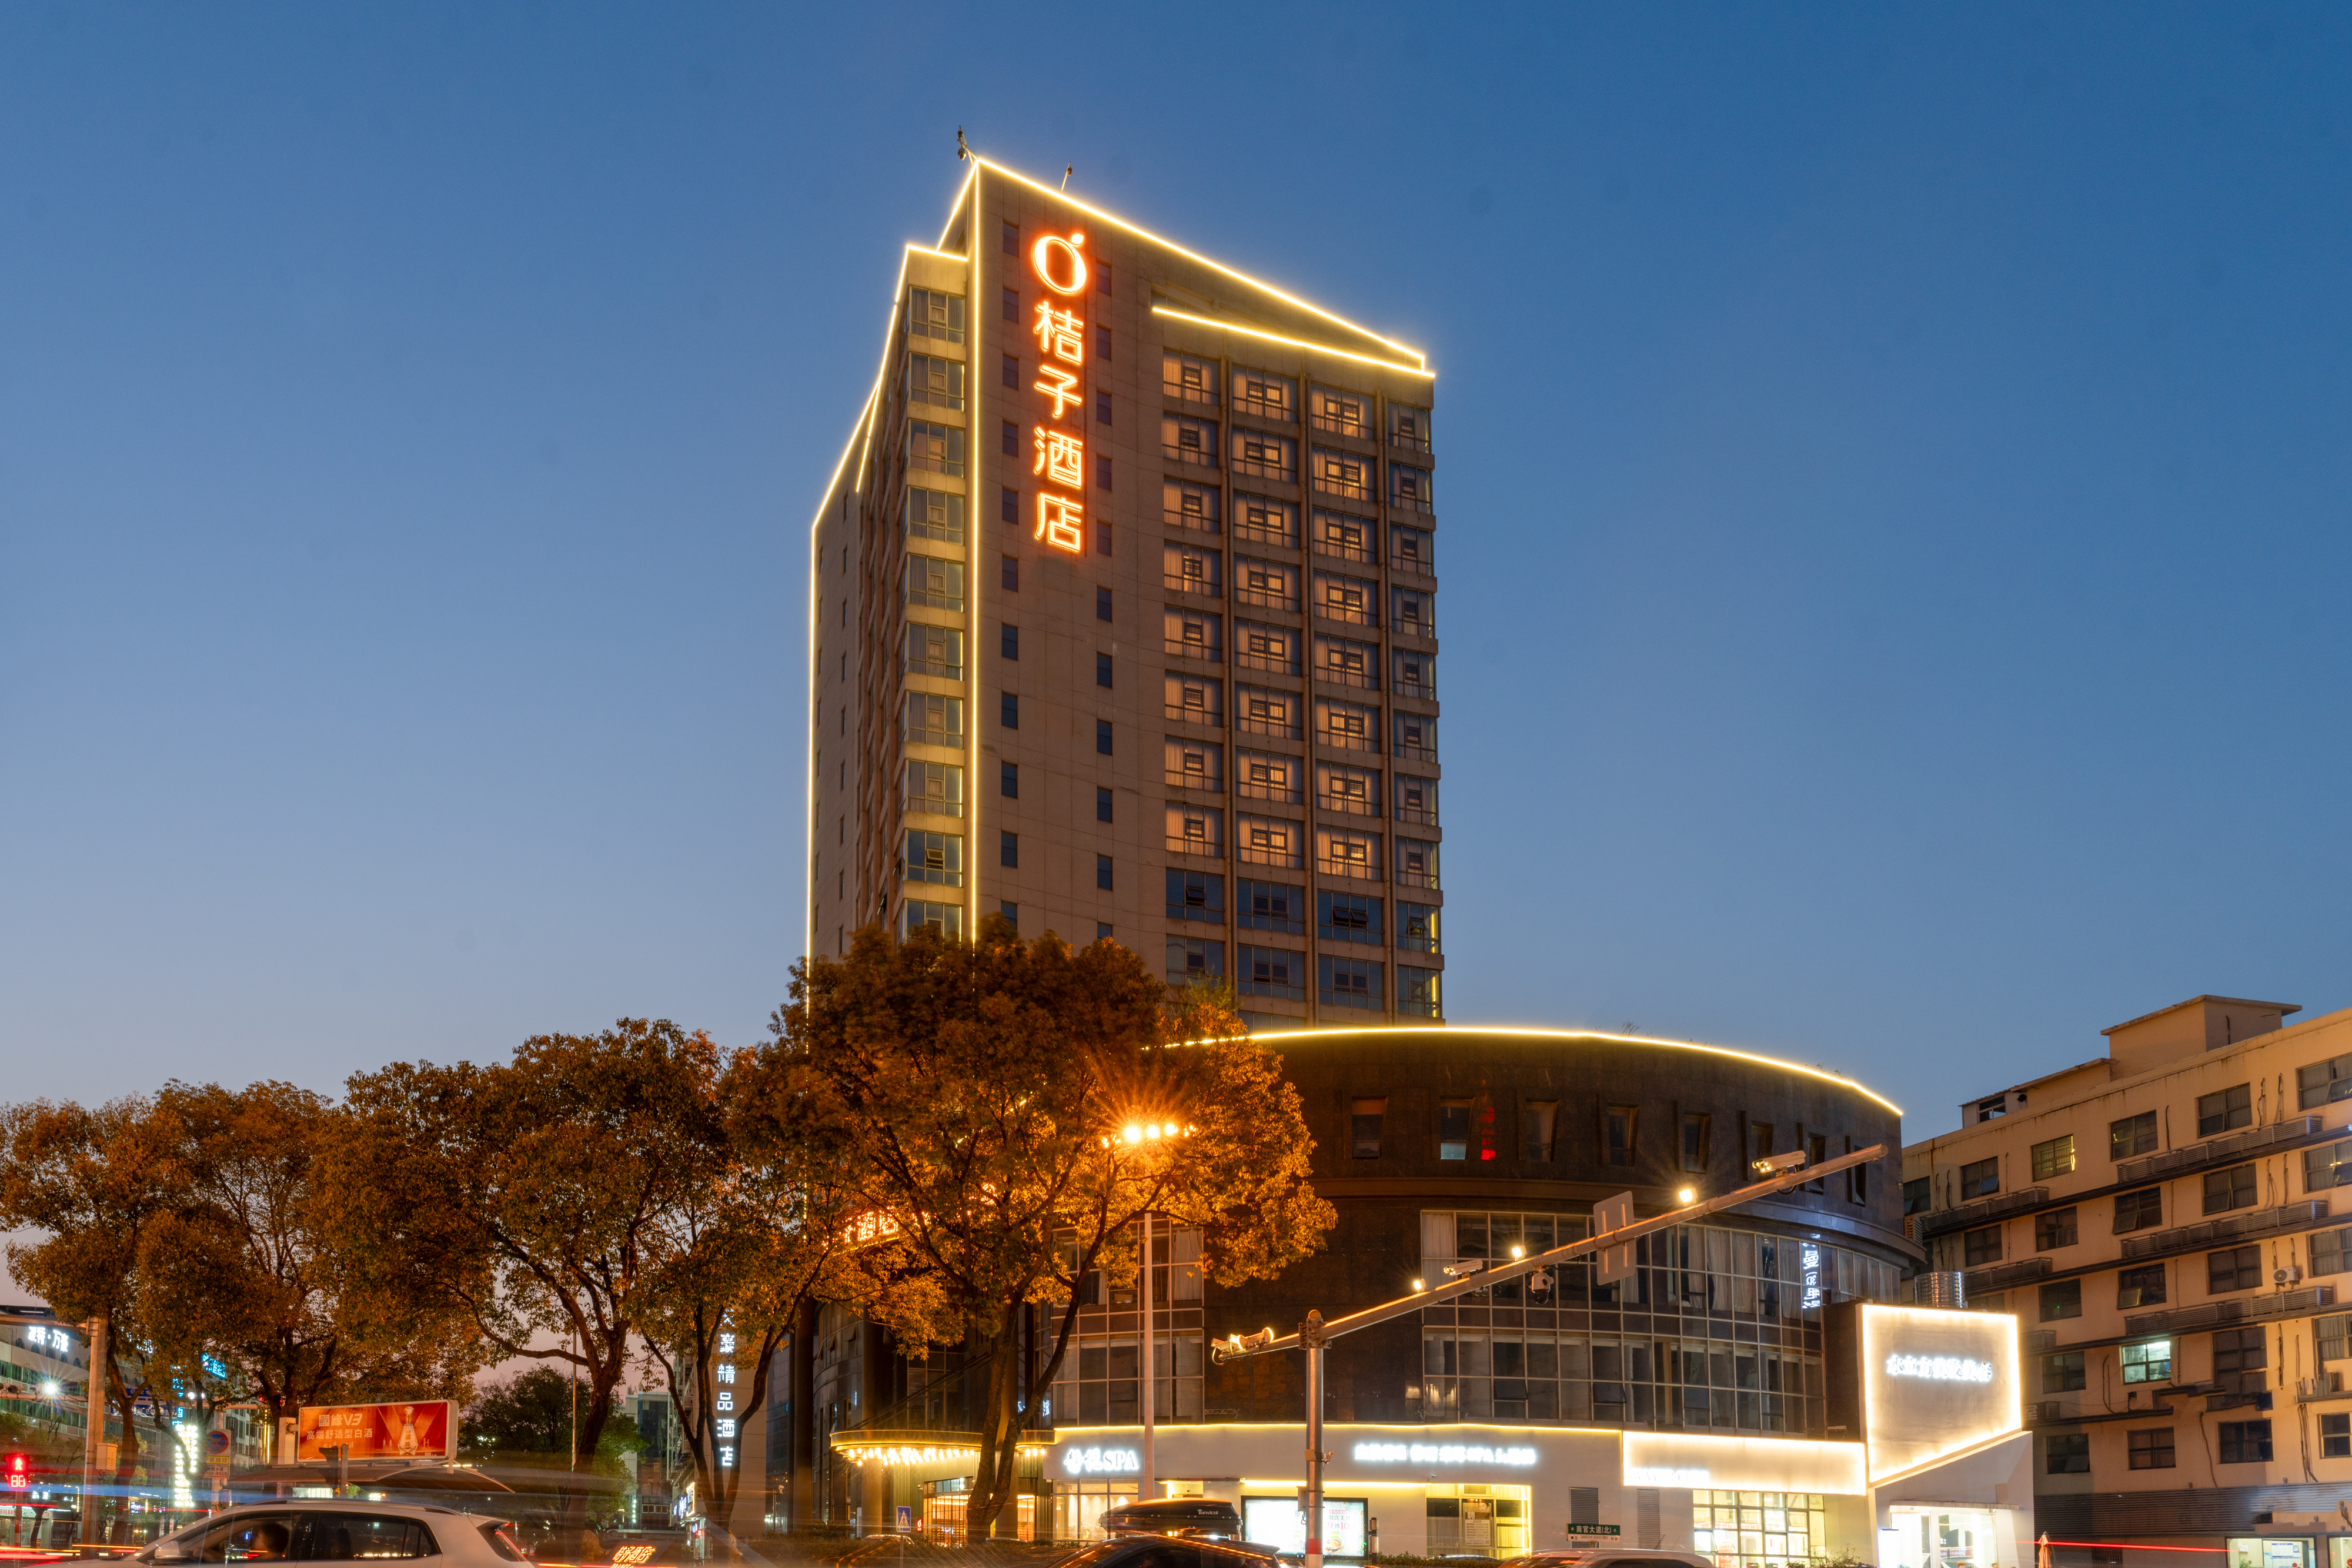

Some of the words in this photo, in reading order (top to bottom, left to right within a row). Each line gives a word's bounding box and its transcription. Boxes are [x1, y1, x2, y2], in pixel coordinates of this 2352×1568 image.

[1034, 300, 1084, 554] 桔子酒店
[318, 1413, 363, 1427] 國緣V3
[306, 1428, 373, 1440] 高端舒适型白酒
[11, 1475, 26, 1487] 86
[1576, 1525, 1612, 1534] 南官大道(北)
